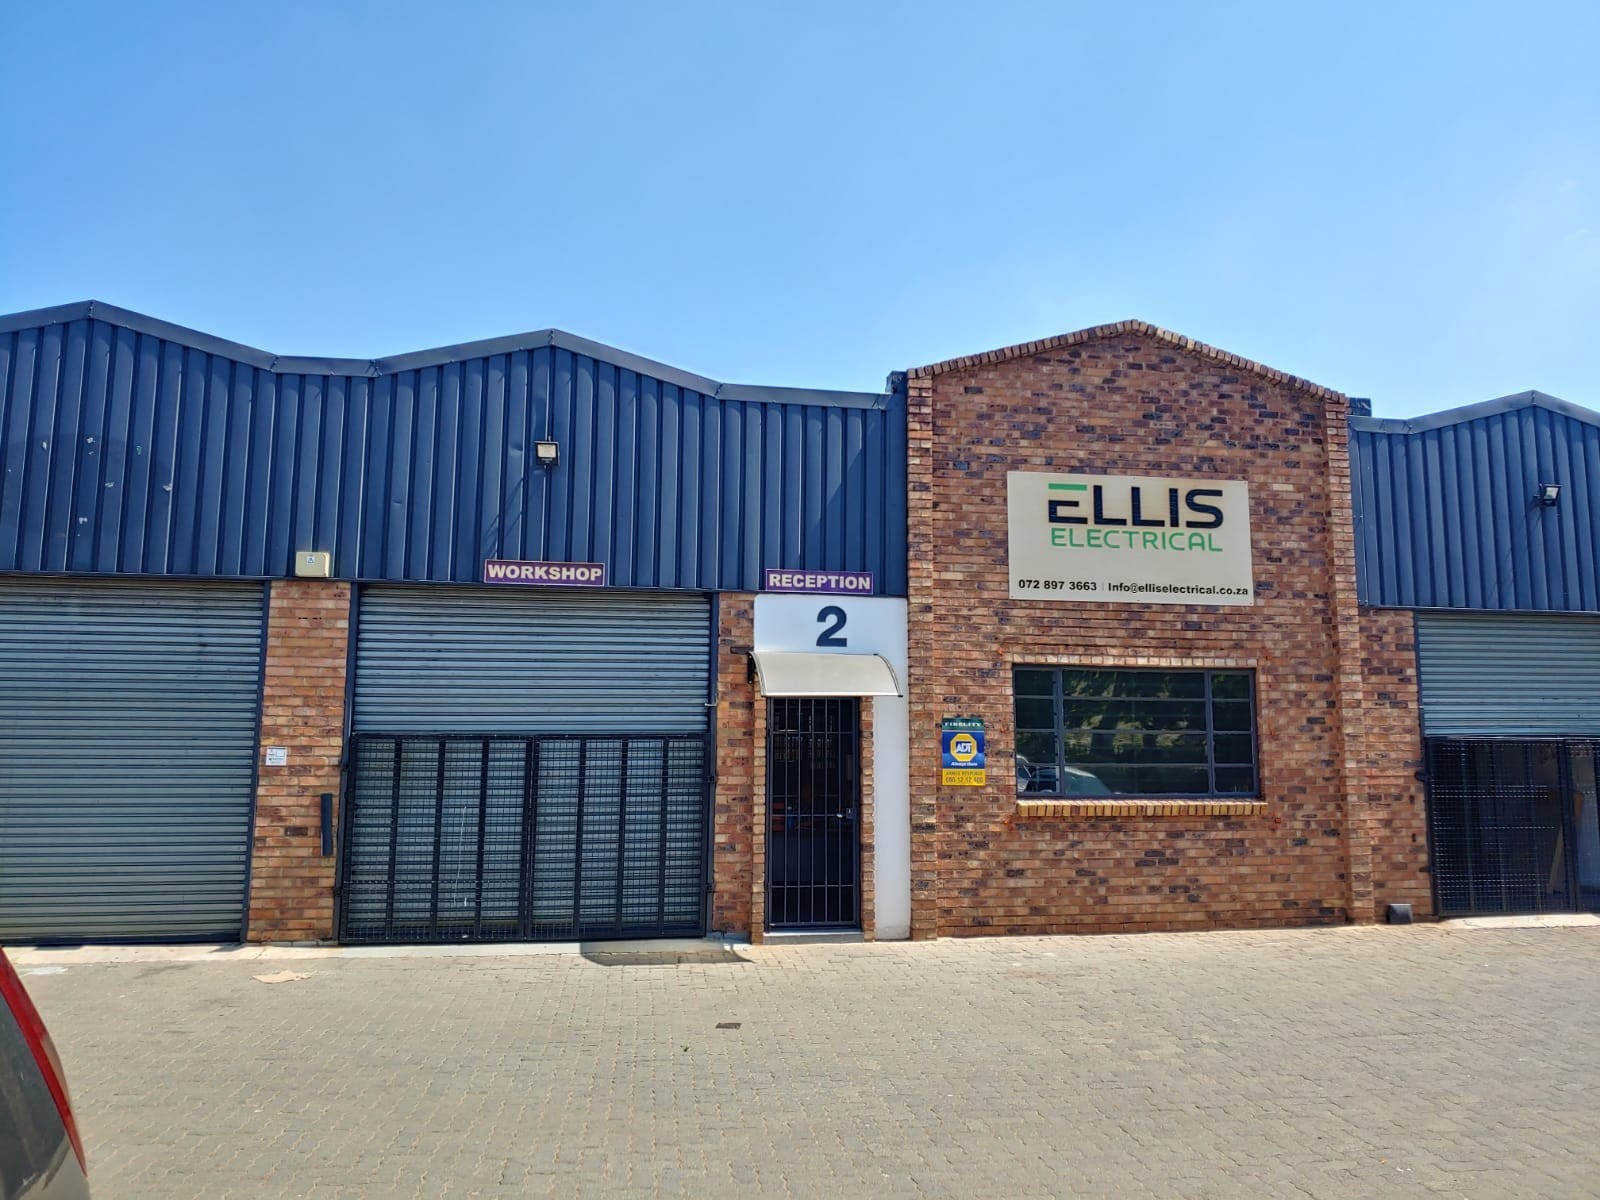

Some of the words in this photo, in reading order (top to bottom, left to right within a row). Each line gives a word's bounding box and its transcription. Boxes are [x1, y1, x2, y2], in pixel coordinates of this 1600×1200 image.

[1048, 483, 1224, 529] ELLIS
[1051, 528, 1223, 552] ELECTRICAL
[487, 564, 602, 581] WORKSHOP
[769, 573, 870, 590] RECEPTION
[1018, 579, 1040, 590] 072
[1043, 580, 1064, 591] 897
[1069, 581, 1097, 592] 3663
[816, 605, 848, 647] 2
[956, 742, 972, 753] ADT
